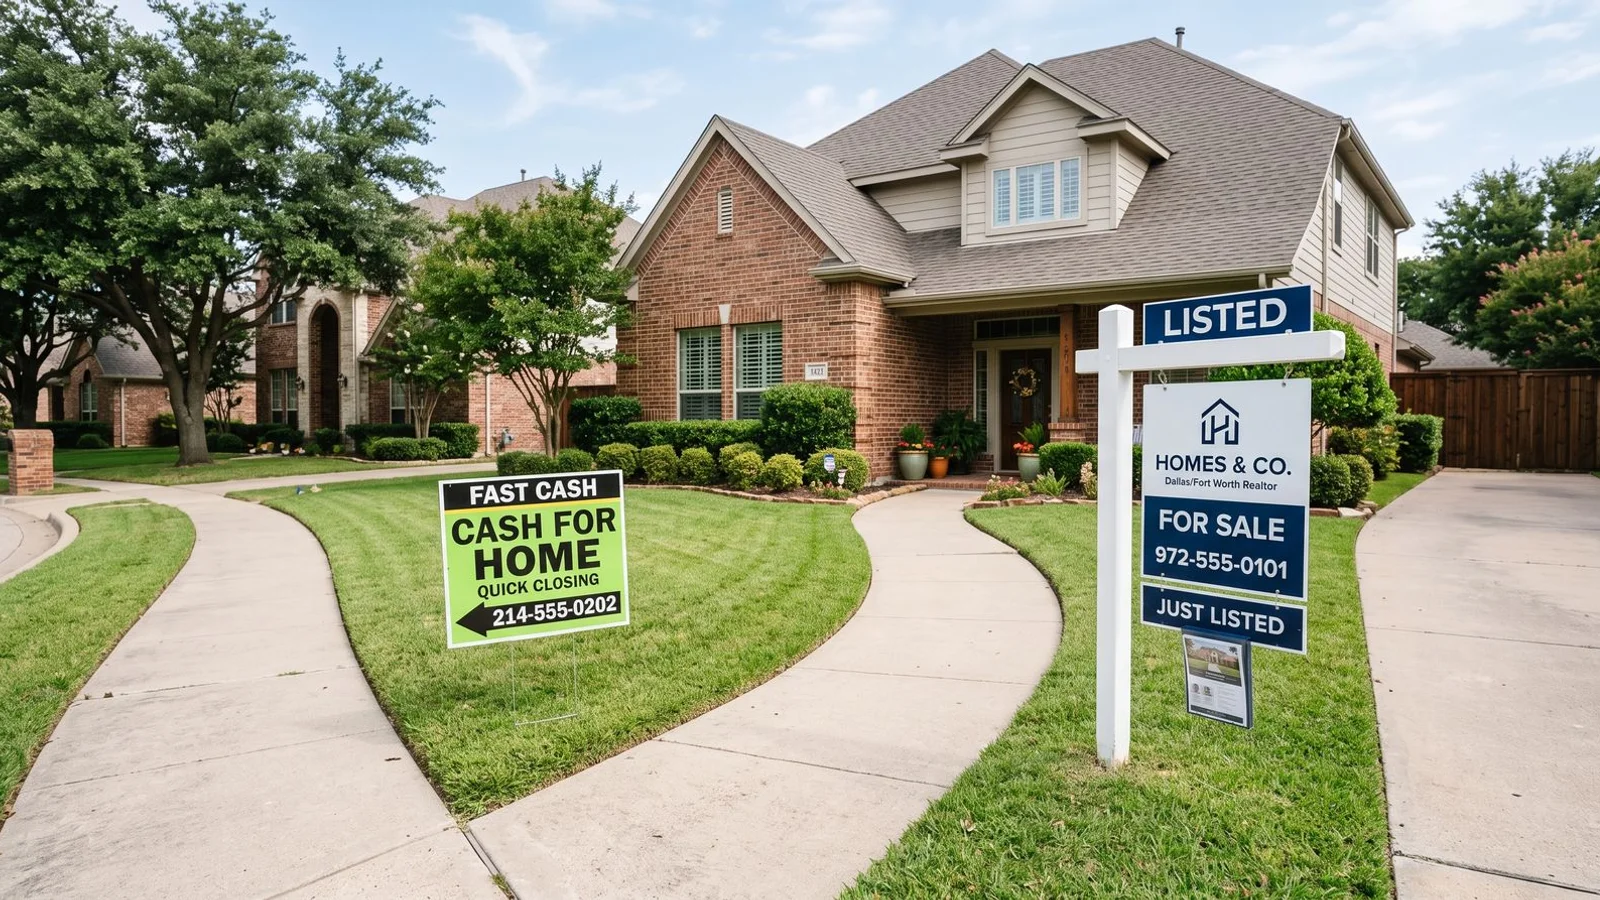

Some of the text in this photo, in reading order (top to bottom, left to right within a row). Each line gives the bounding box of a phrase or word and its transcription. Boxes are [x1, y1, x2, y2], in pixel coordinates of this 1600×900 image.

[1164, 298, 1287, 337] LISTED
[1156, 454, 1291, 475] HOMES & CO.
[470, 478, 597, 505] FAST CASH
[1165, 477, 1278, 491] Dallas/Fort Worth Realtor
[452, 507, 616, 545] CASH FOR
[1159, 509, 1285, 542] FOR SALE
[475, 539, 601, 580] HOME
[1155, 546, 1287, 579] 972-555-0101
[478, 573, 599, 600] QUICK CLOSING
[493, 595, 617, 626] 214-555-0202
[1156, 598, 1285, 635] JUST LISTED
